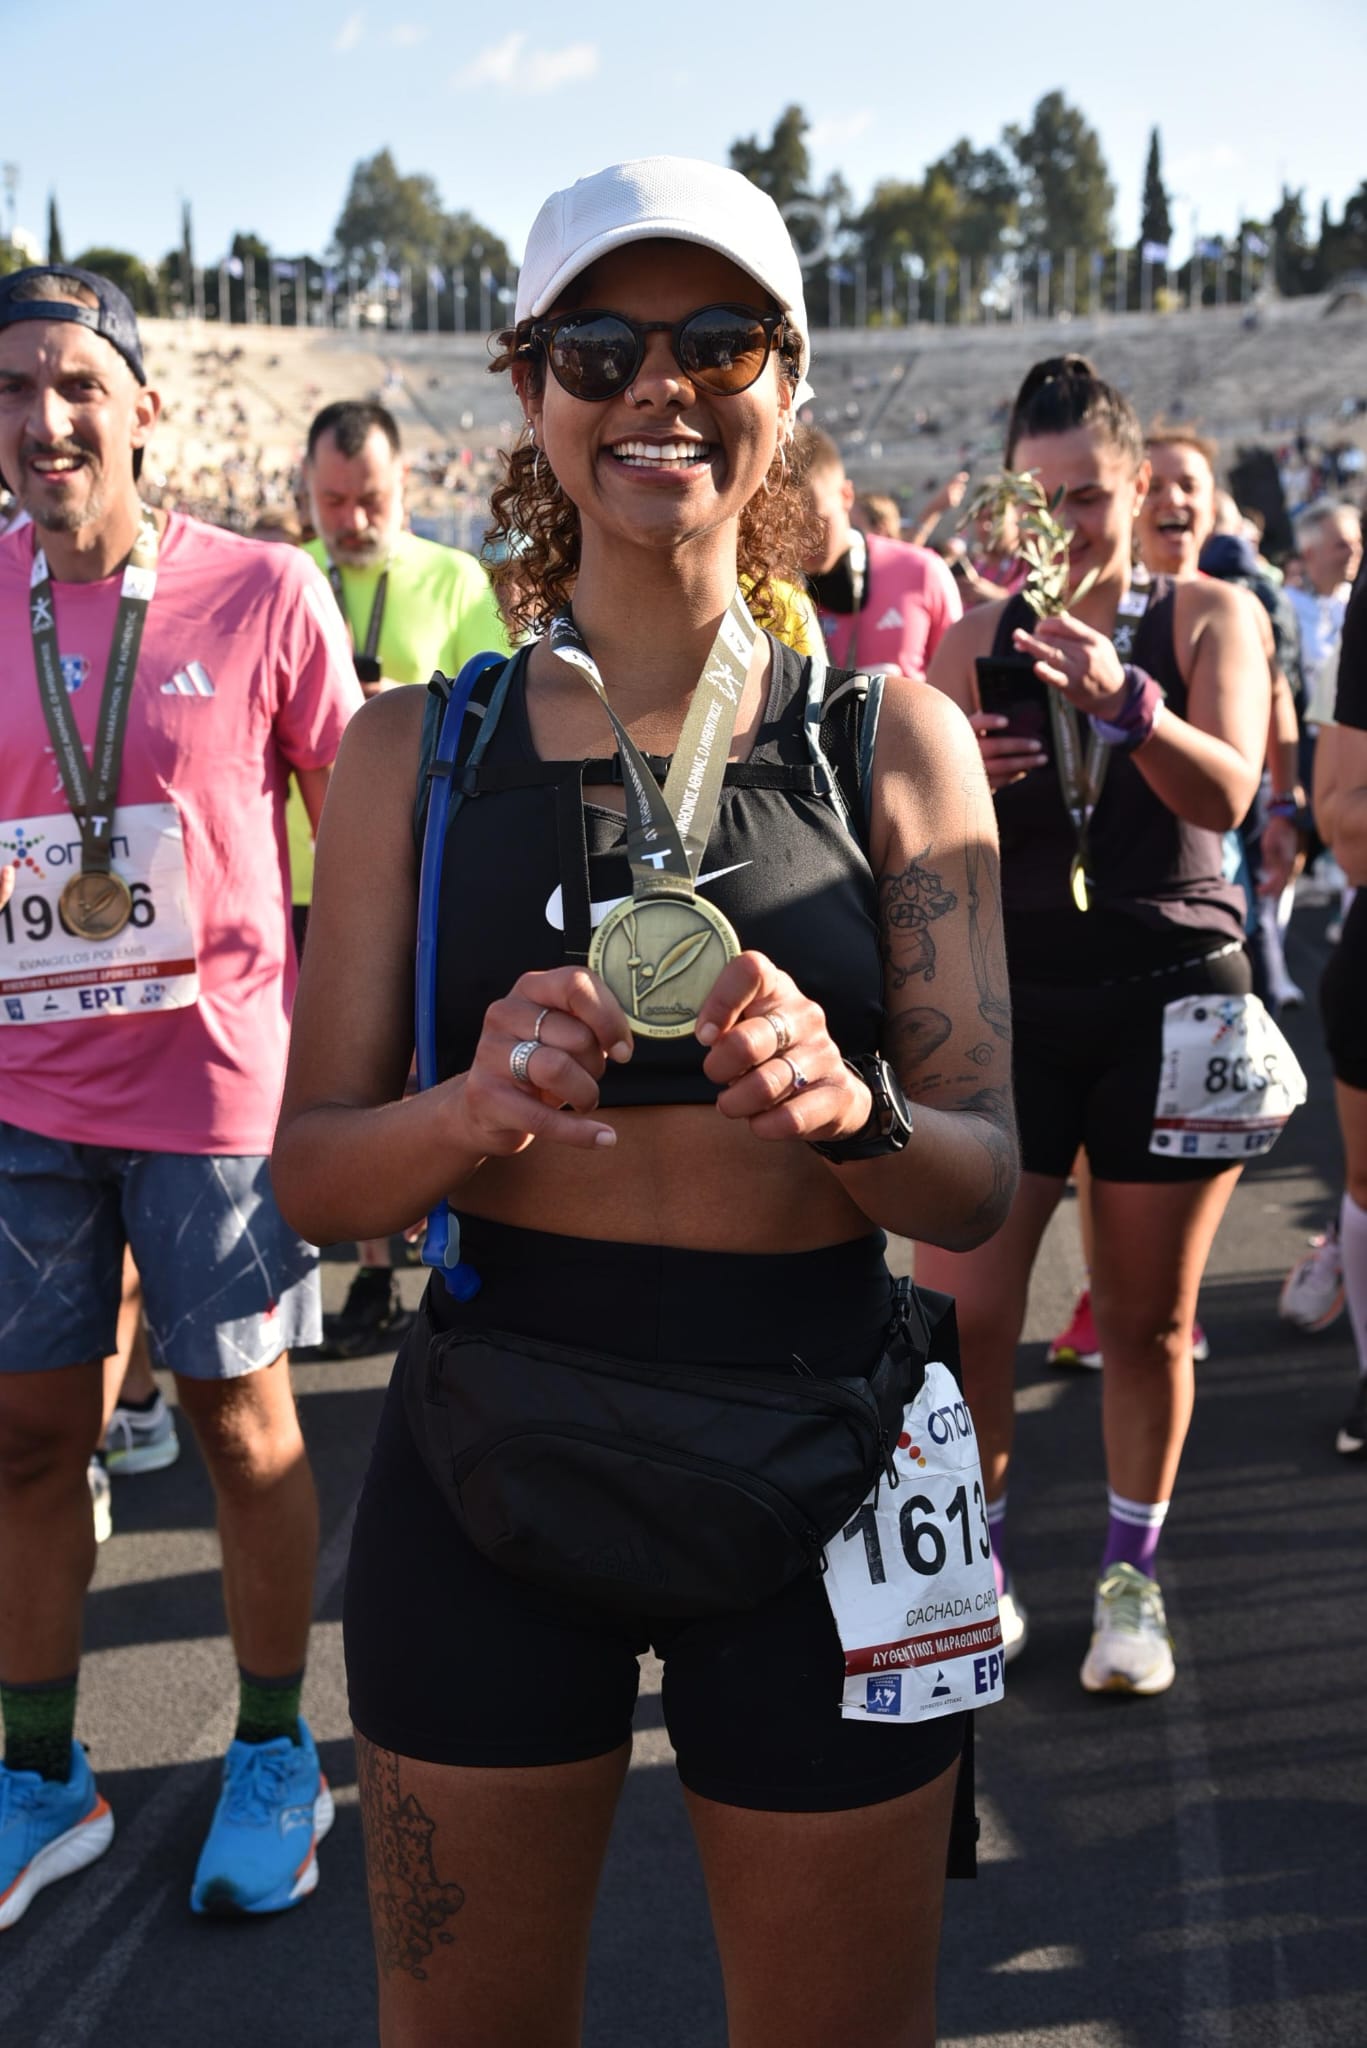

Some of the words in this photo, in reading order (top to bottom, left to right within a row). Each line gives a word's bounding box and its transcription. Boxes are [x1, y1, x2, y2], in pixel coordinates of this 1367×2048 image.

[0, 882, 156, 944] 196
[906, 1598, 972, 1627] CACHADA
[872, 1640, 935, 1667] ΑΥΘΕΝΤΙΚΟΣ
[936, 1626, 992, 1654] ΜΑΡΑΘΩΝΙΟΣ
